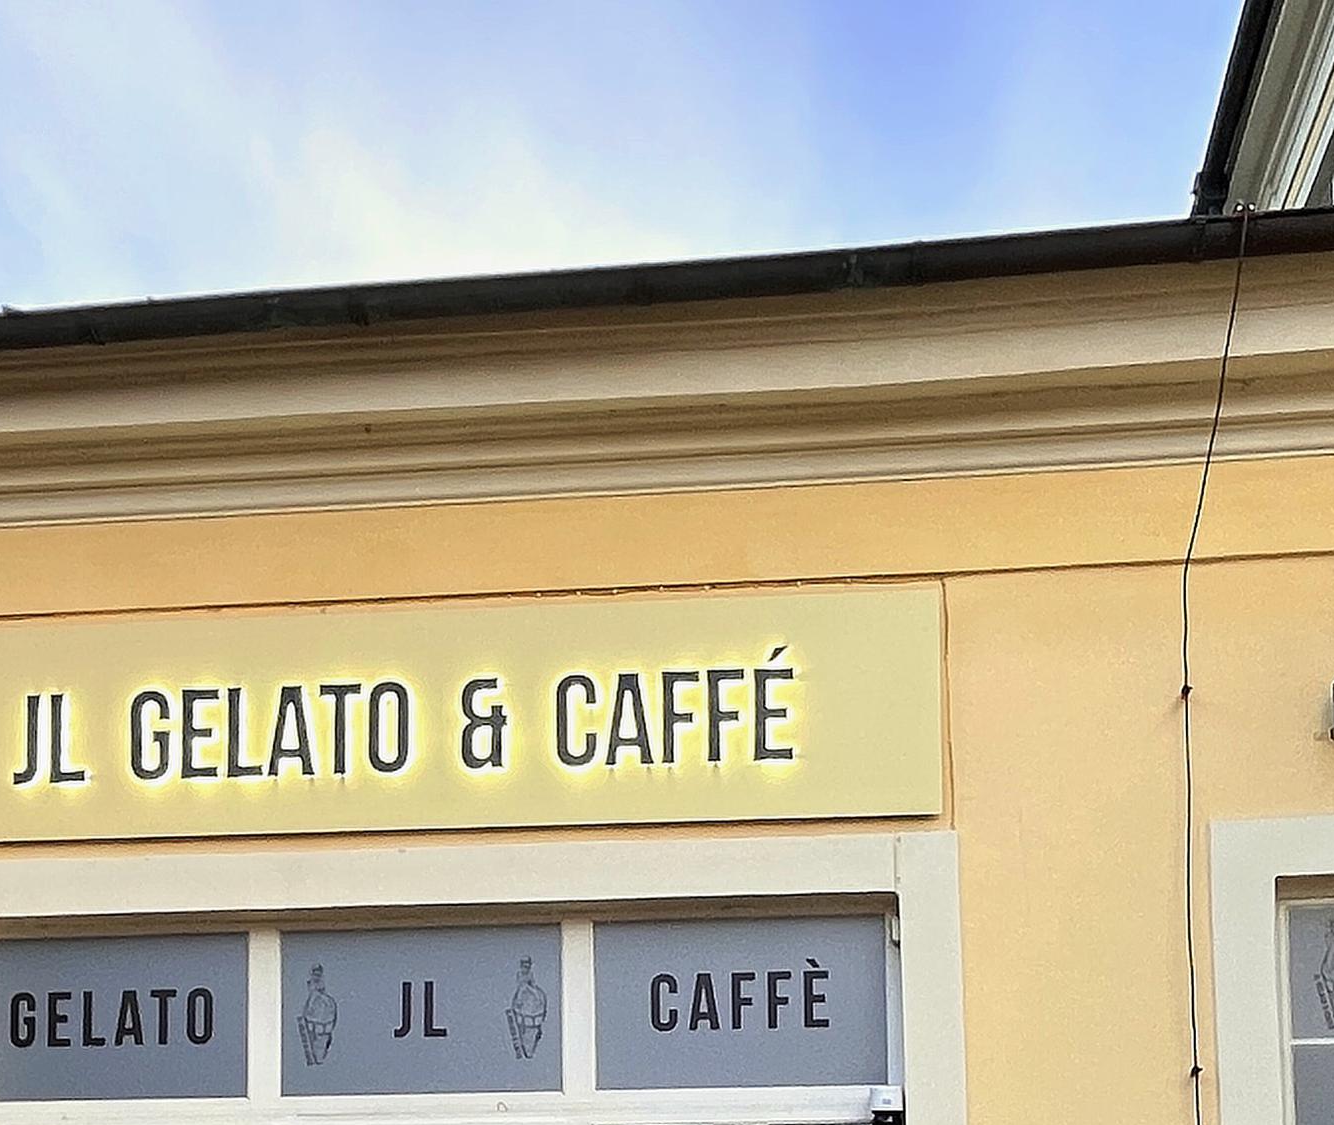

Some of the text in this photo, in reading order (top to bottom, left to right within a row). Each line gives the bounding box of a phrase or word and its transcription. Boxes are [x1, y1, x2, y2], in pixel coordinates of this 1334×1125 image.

[13, 645, 794, 785] JL GELATO & CAFFÉ
[10, 987, 214, 1048] GELATO
[393, 980, 449, 1038] JL
[650, 958, 830, 1032] CAFFÈ
